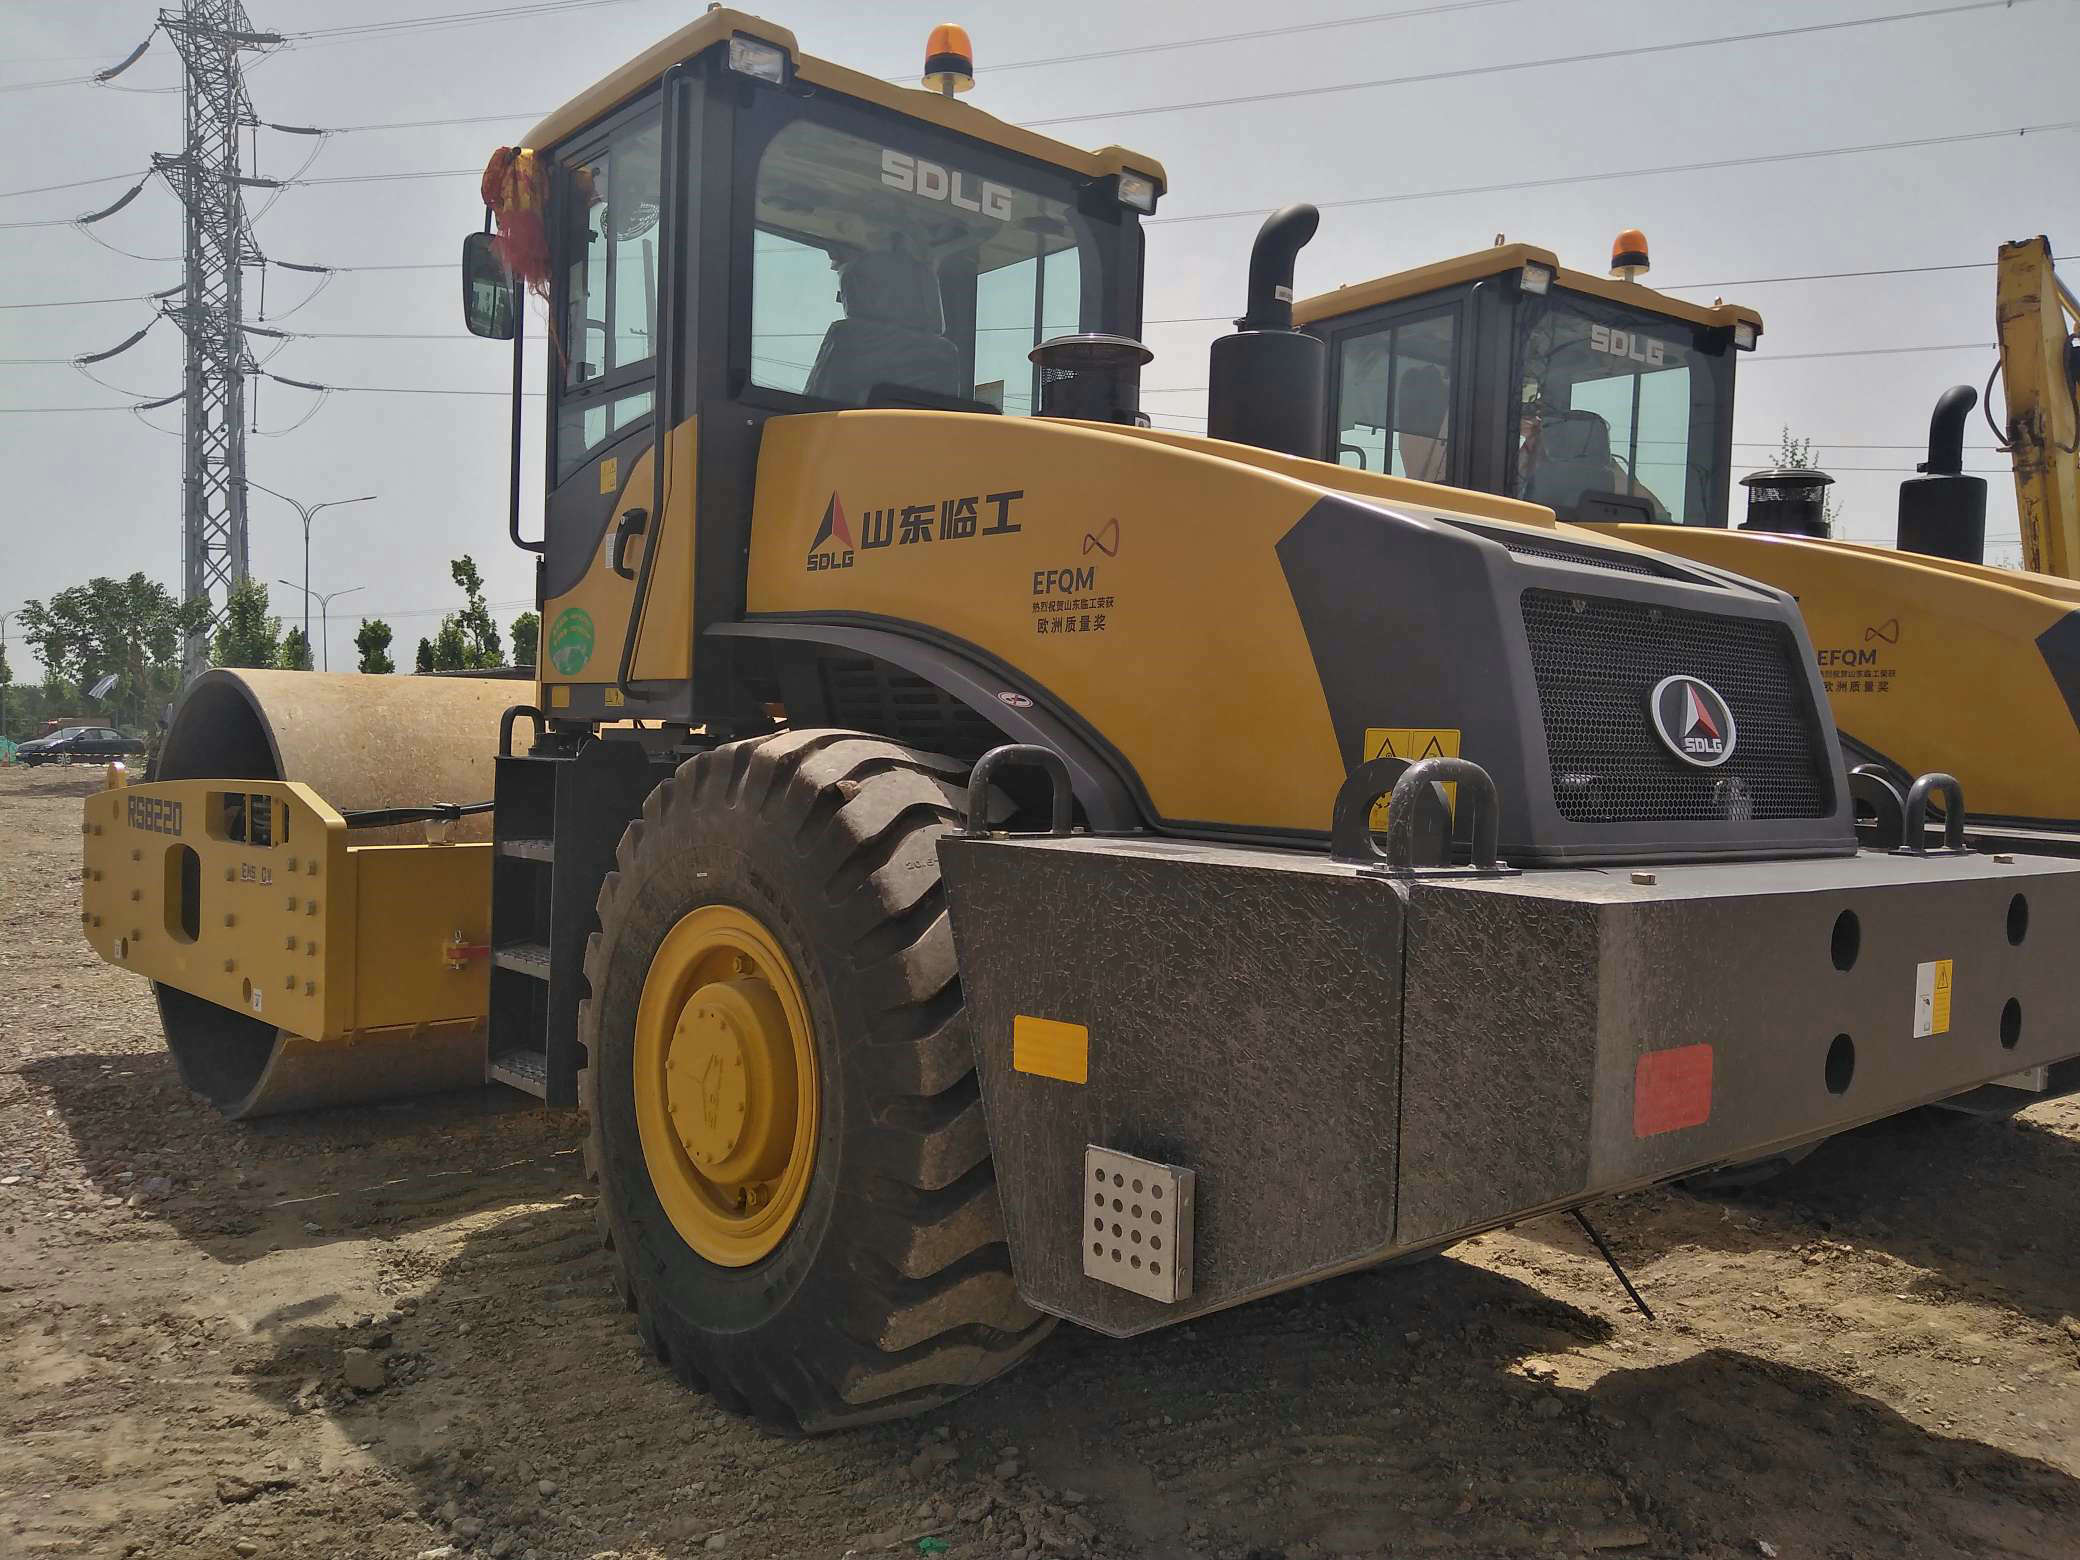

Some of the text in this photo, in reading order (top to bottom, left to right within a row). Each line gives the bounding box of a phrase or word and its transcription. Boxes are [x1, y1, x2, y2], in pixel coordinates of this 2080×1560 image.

[881, 149, 1012, 222] SDLG
[1591, 324, 1664, 367] SDLG
[861, 490, 1024, 550] 山东临工
[807, 551, 854, 571] SDLG
[1033, 567, 1095, 594] EFQM
[1037, 614, 1106, 634] 欧洲质量奖
[1817, 648, 1877, 666] EFQM
[1684, 737, 1723, 753] SDLG
